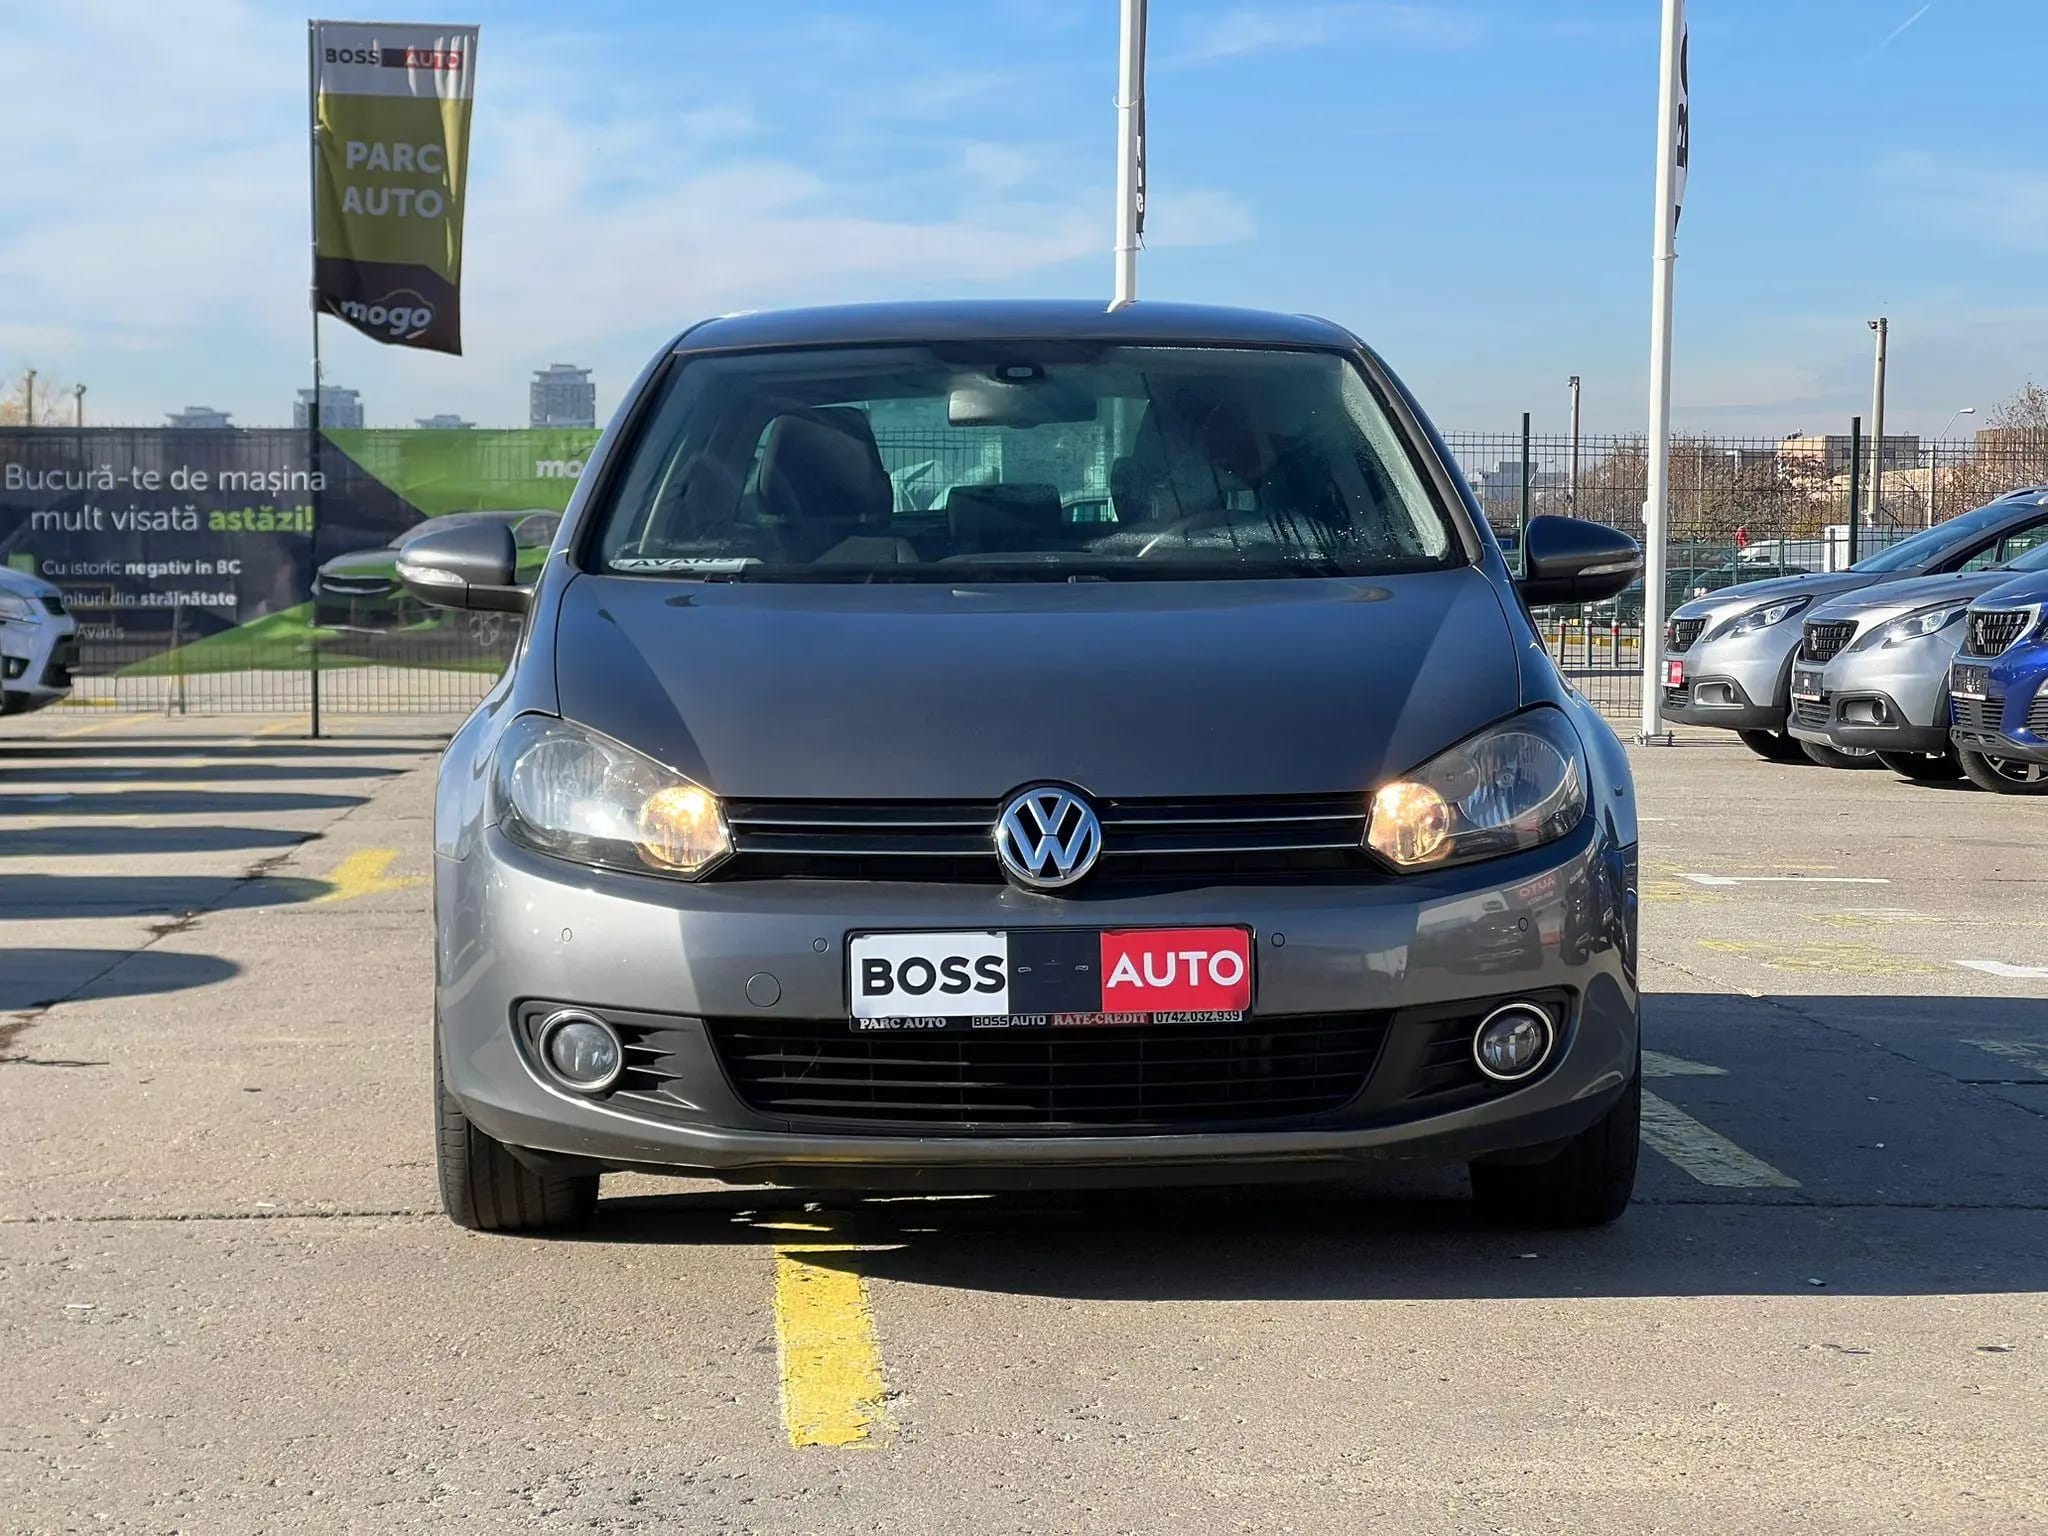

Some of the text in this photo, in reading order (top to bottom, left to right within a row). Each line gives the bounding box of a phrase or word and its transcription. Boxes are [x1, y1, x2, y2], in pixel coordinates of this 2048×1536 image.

[326, 48, 460, 68] BOSS AUTO
[345, 141, 443, 174] PARC
[341, 186, 444, 219] AUTO
[340, 300, 433, 336] mogo
[5, 463, 327, 498] Bucură-te de mașina
[535, 459, 585, 478] mo
[31, 504, 314, 532] mult visată astăzi!
[42, 560, 66, 576] Cu
[70, 560, 121, 576] istoric
[125, 560, 191, 579] negativ
[216, 559, 242, 575] BC
[63, 591, 104, 606] nituri
[110, 591, 135, 606] din
[862, 950, 1244, 996] BOSS AUTO
[859, 1018, 901, 1030] PARC
[903, 1017, 947, 1029] AUTO
[973, 1016, 1009, 1028] BOSS
[1011, 1015, 1047, 1026] AUTO
